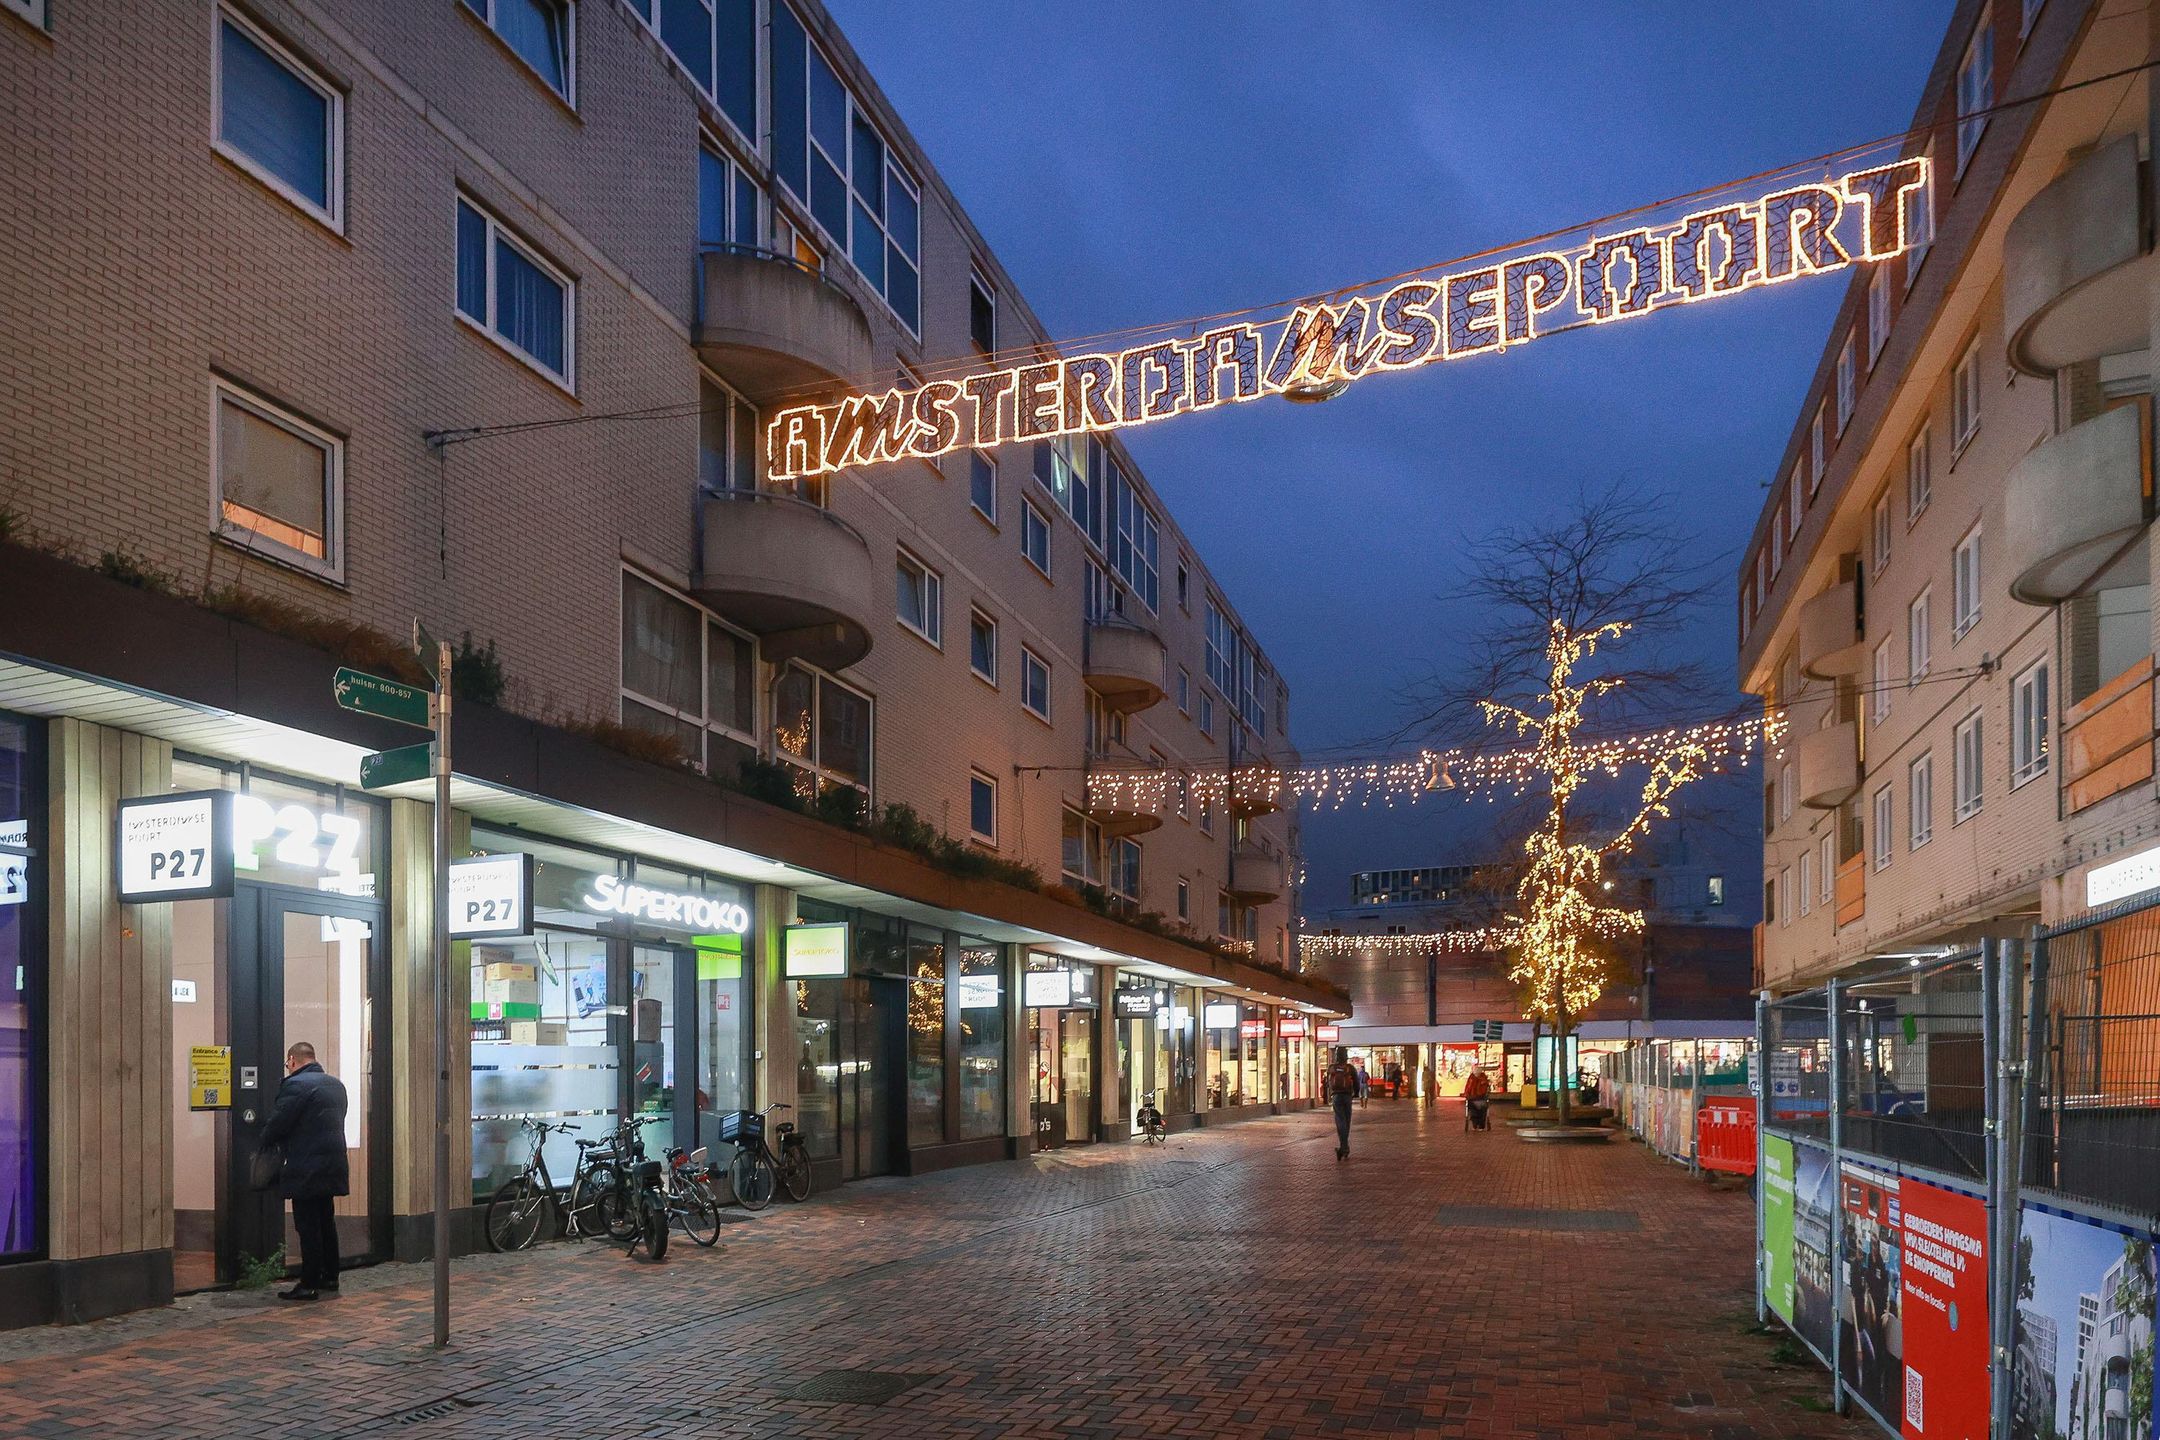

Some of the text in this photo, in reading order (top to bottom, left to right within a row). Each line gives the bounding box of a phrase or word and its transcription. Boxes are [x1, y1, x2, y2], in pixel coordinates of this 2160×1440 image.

[150, 848, 205, 880] P27
[466, 898, 513, 923] P27
[584, 874, 749, 933] SUPERTOKO
[192, 1047, 218, 1055] Entrance
